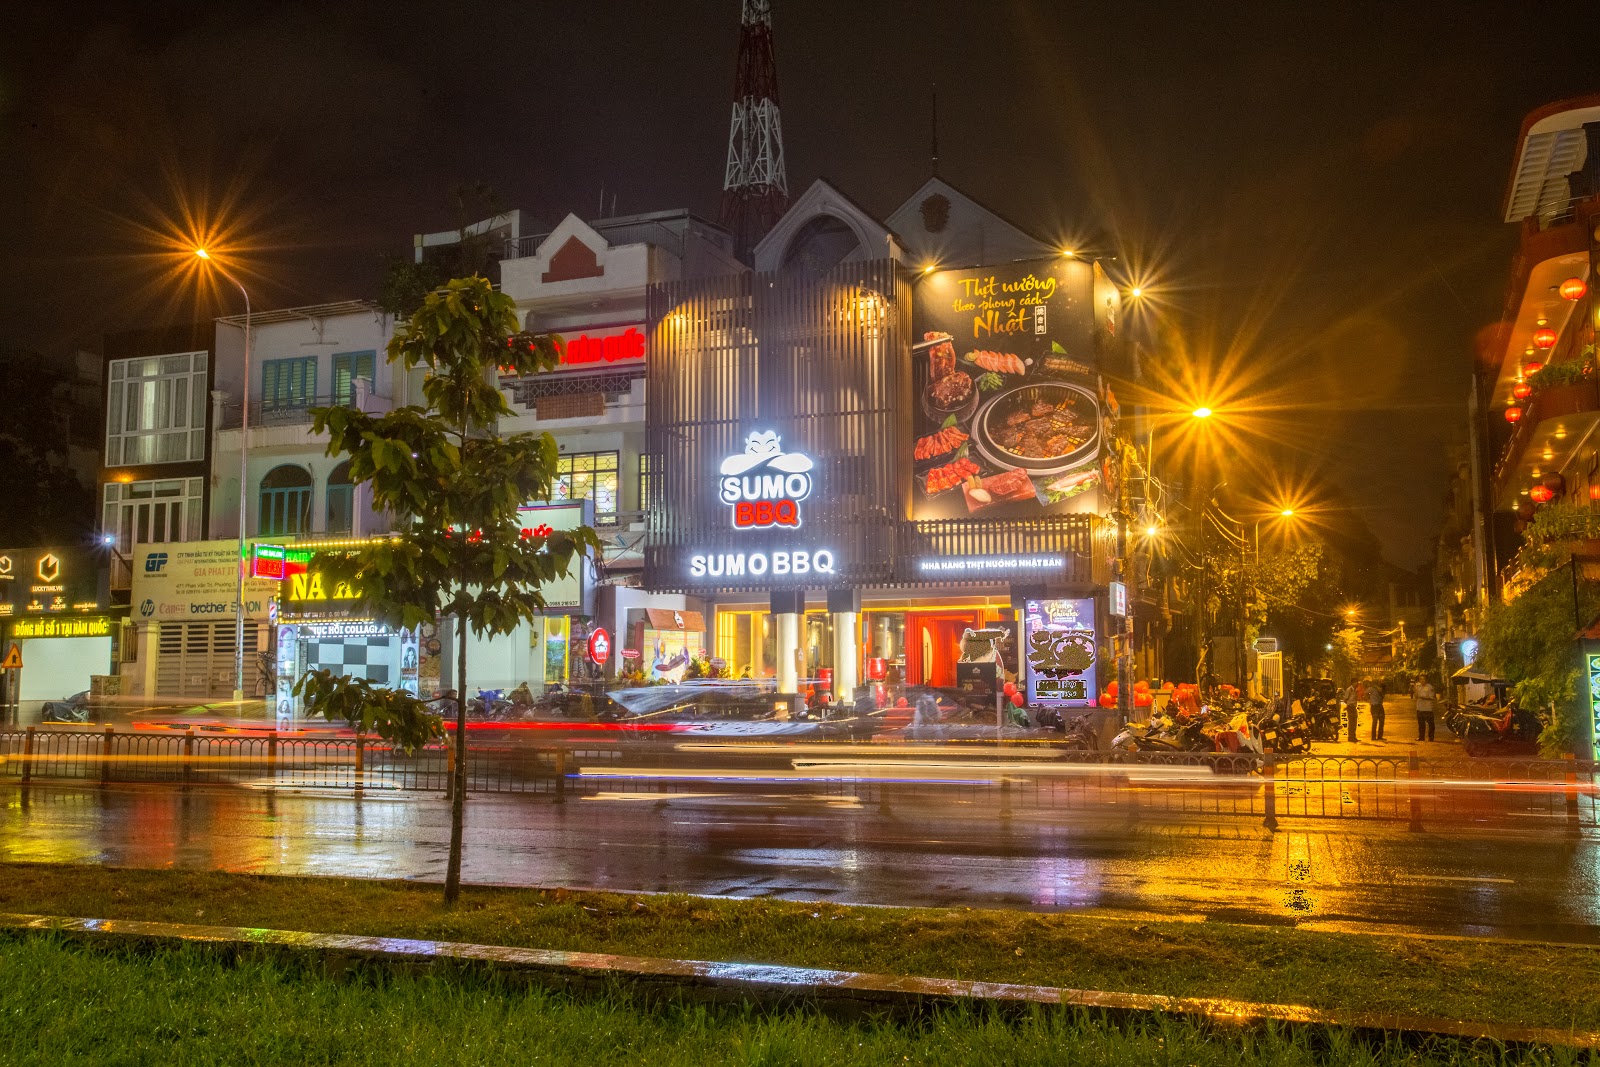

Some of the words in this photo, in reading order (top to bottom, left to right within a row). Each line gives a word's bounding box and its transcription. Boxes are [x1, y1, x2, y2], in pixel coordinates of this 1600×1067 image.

[958, 275, 999, 298] Thịt
[1002, 274, 1056, 299] nướng
[952, 299, 975, 313] theo
[978, 296, 1015, 318] phong
[1019, 293, 1044, 305] cách
[973, 307, 1031, 338] Nhật
[723, 474, 808, 500] SUMO
[736, 499, 798, 527] BBQ
[194, 567, 207, 577] GIA
[690, 553, 768, 577] SUMO
[773, 550, 835, 574] BBQ
[922, 560, 940, 569] NHÀ
[941, 560, 965, 569] HÀNG
[966, 560, 985, 570] THỊT
[141, 599, 155, 617] hp
[190, 602, 227, 613] brother
[231, 601, 261, 613] EON
[56, 623, 60, 635] 1
[61, 622, 73, 637] TẠI
[88, 618, 107, 636] QUỐC
